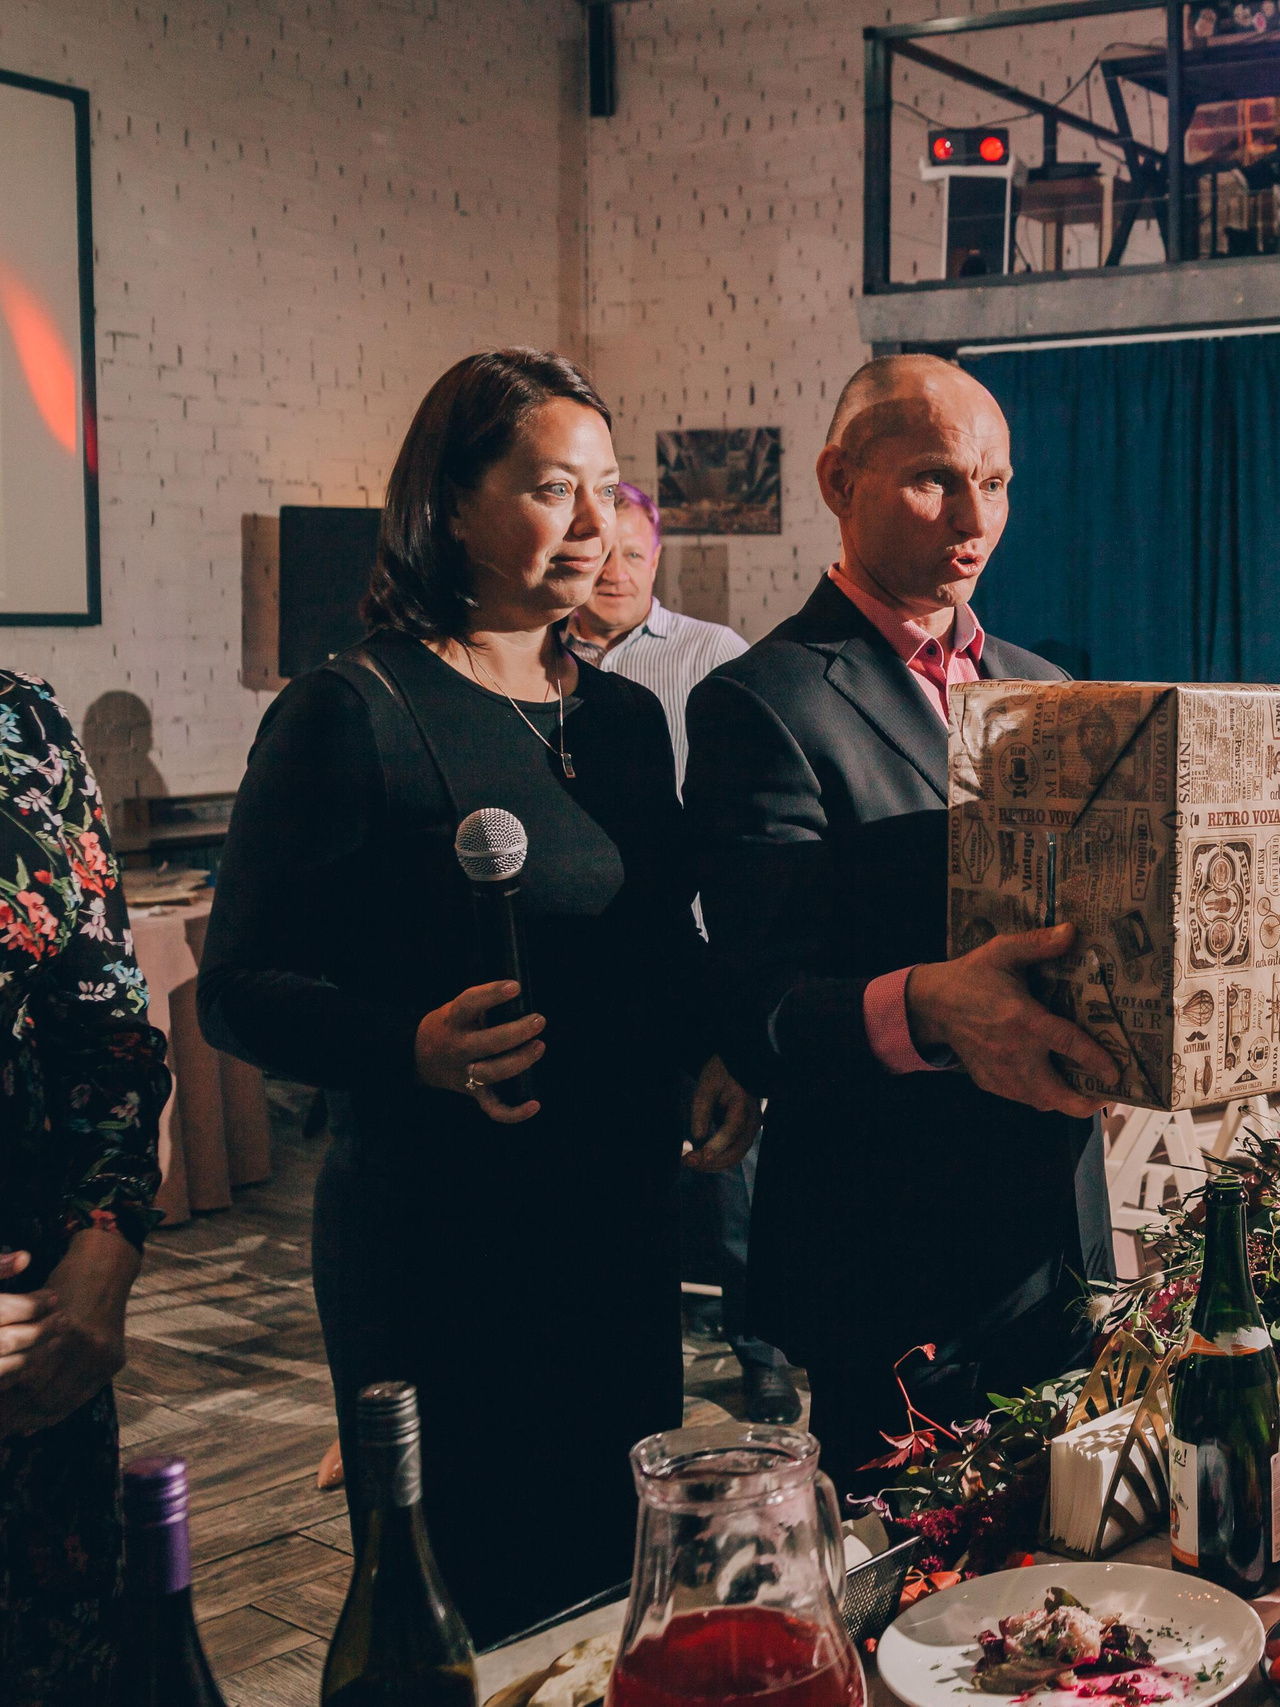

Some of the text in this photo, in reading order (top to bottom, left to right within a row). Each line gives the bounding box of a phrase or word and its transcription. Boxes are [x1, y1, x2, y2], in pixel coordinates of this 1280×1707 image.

[1178, 742, 1191, 803] NEWS
[999, 808, 1045, 823] RETRO
[1208, 811, 1250, 827] RETRO
[1136, 823, 1147, 886] ORIGINAL
[1183, 1040, 1211, 1054] GENTLEMAN
